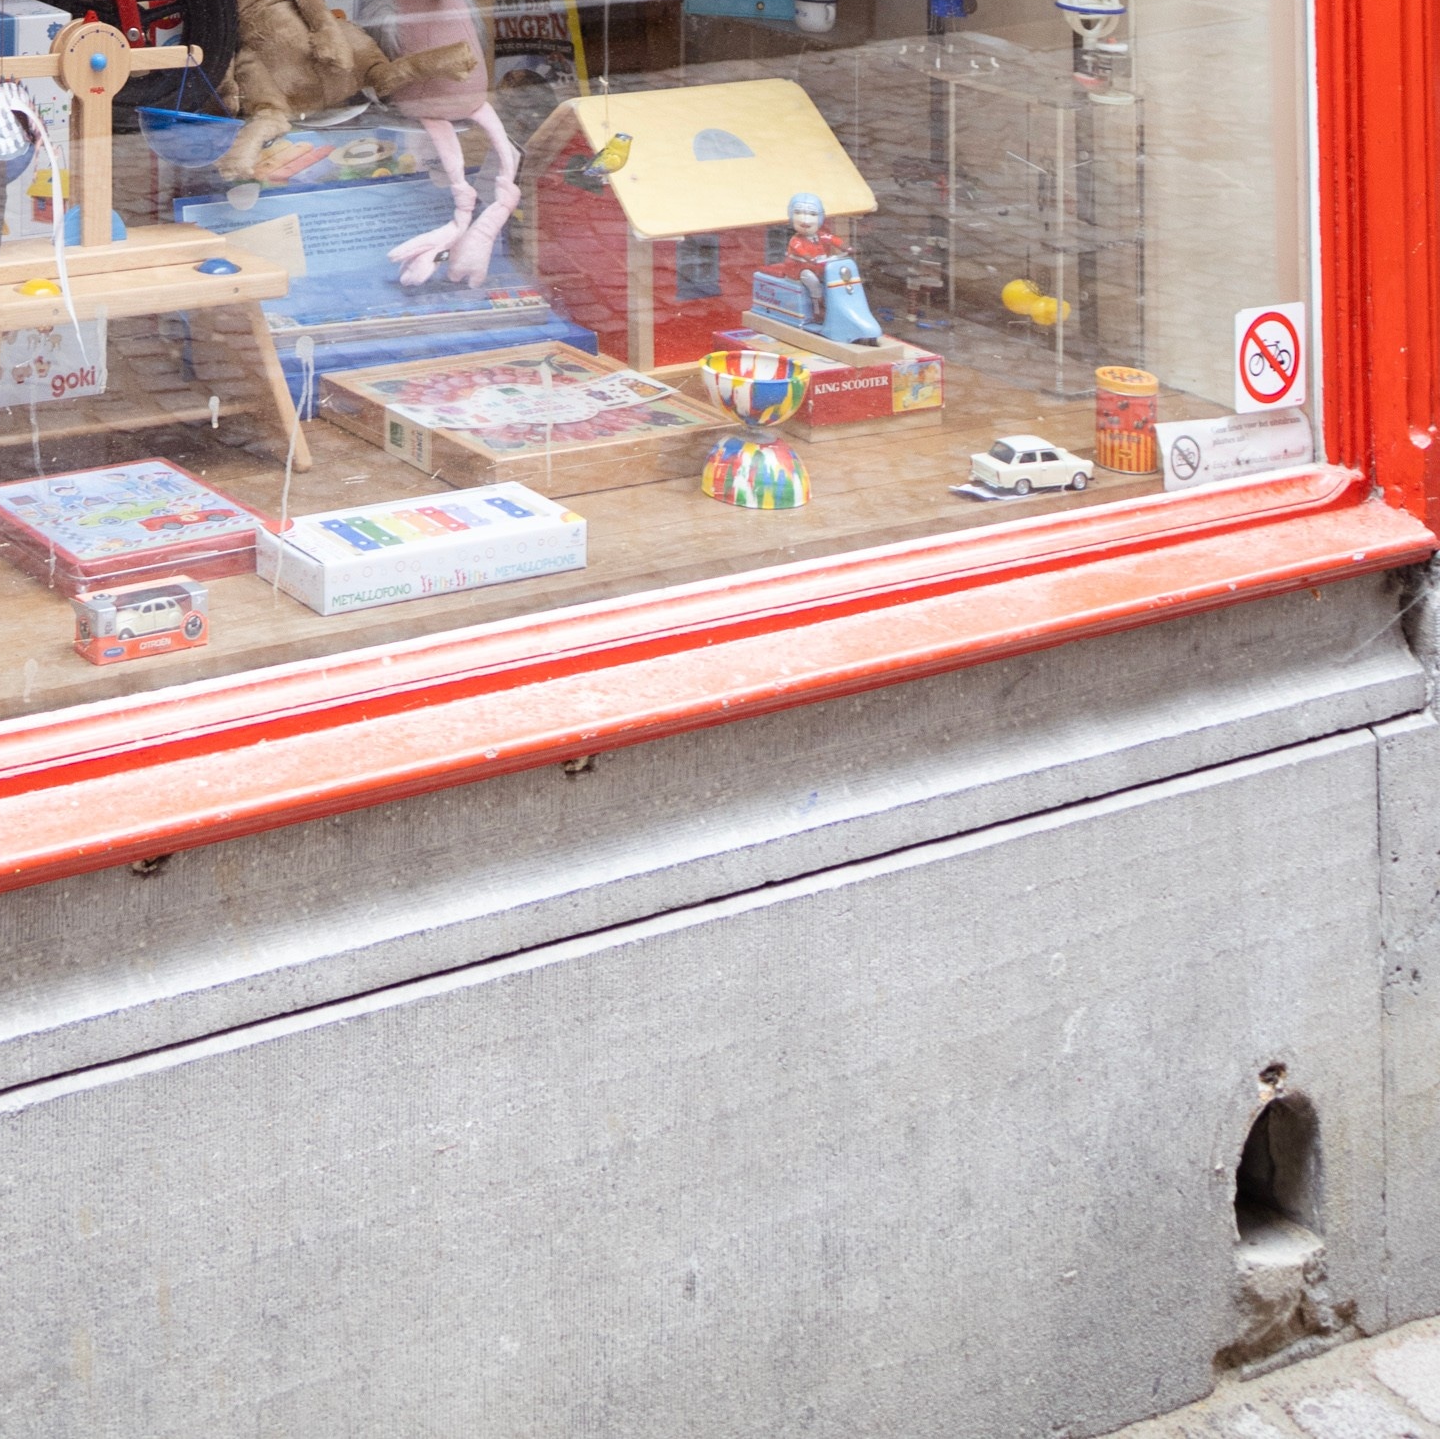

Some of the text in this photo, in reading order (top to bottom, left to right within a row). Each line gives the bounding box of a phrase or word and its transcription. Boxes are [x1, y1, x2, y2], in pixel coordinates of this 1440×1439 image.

[51, 365, 96, 398] goki
[815, 376, 889, 395] KING SCOOTER
[494, 553, 577, 578] METALLOPHONE
[332, 583, 412, 607] METALLOFONO
